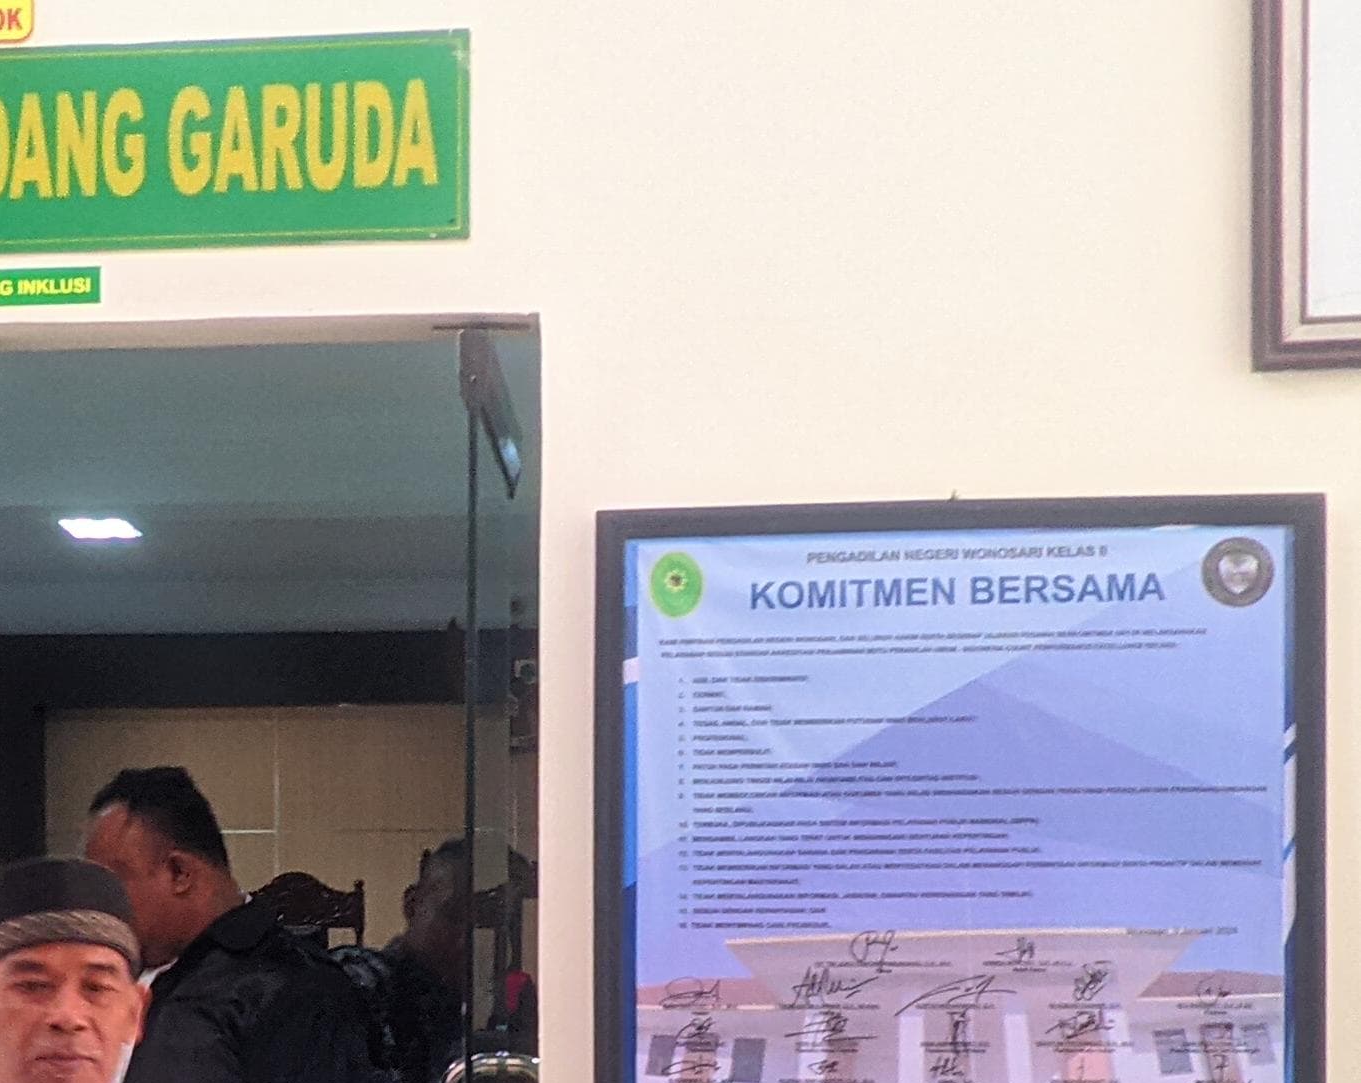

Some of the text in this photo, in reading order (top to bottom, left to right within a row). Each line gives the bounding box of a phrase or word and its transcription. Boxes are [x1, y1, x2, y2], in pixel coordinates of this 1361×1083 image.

[167, 77, 440, 197] GARUDA
[17, 277, 91, 295] INKLUSI
[806, 551, 900, 565] PENGADILAN
[904, 548, 959, 562] NEGERI
[962, 547, 1042, 560] WONOSARI
[1046, 545, 1096, 558] KELAS
[750, 572, 1166, 610] KOMITMEN BERSAMA
